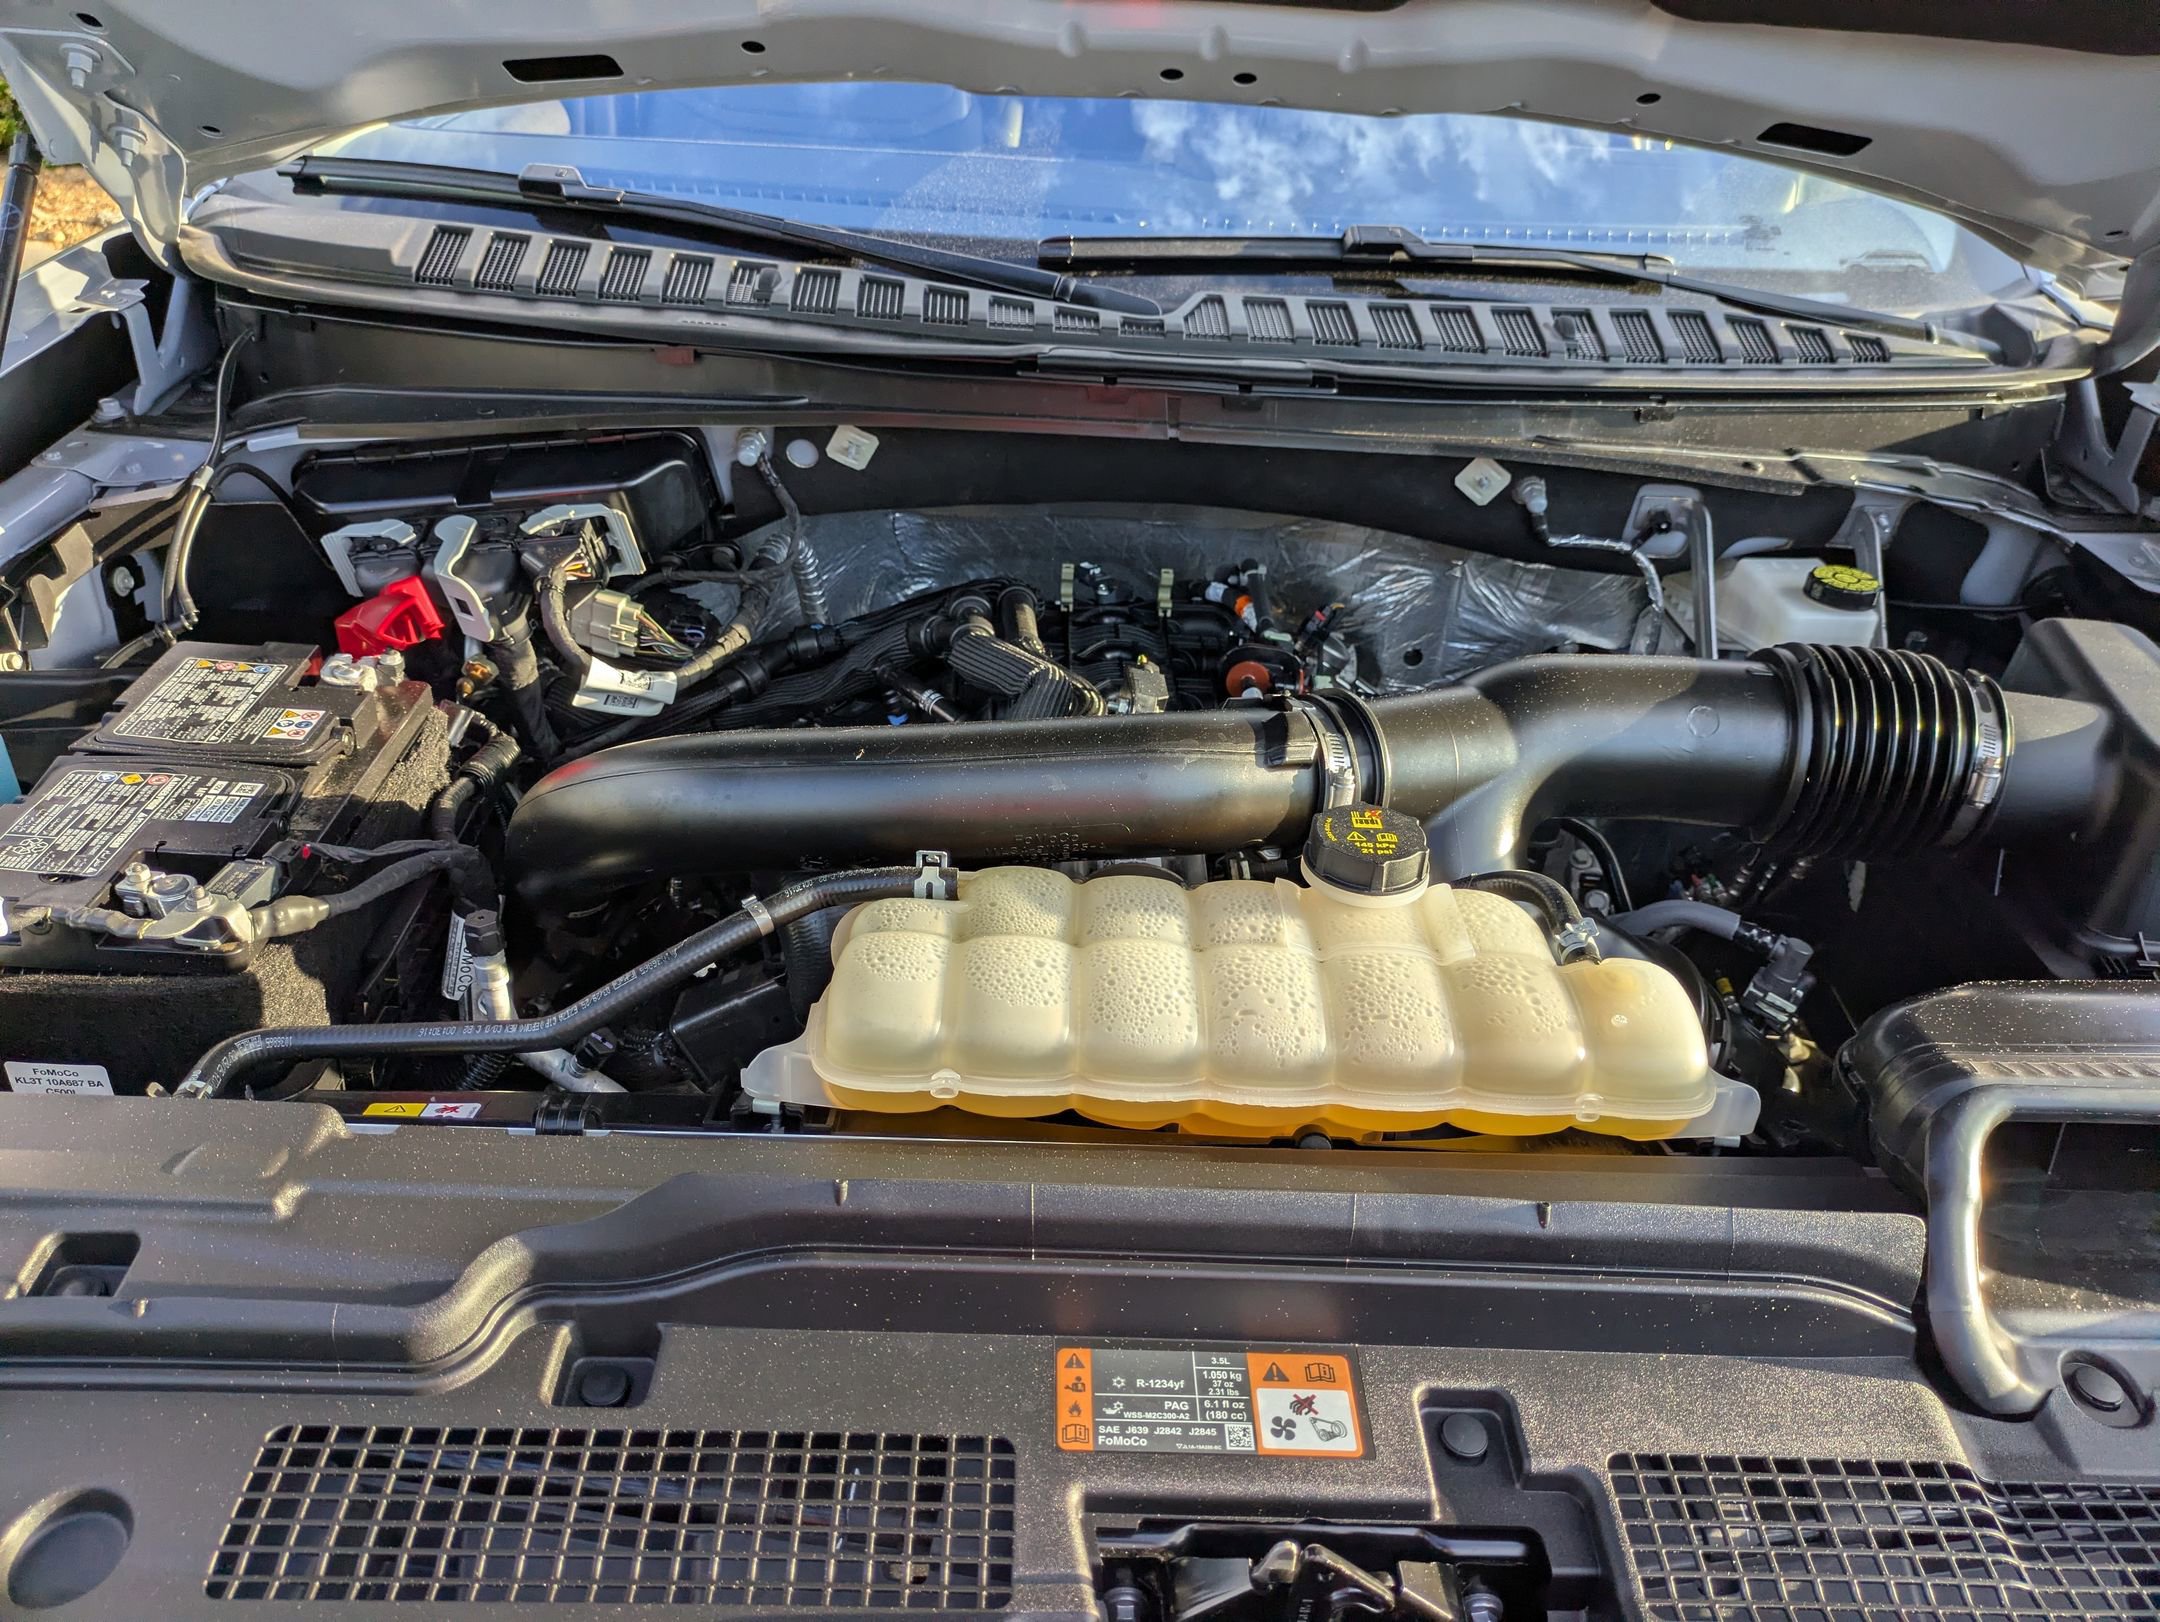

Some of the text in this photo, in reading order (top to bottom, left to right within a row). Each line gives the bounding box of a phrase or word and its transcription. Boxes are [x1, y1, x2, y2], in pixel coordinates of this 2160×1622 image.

[32, 1068, 80, 1078] FoMoCo
[14, 1076, 105, 1088] KL3T 10A687 BA
[1211, 1356, 1231, 1365] 3.5L
[1202, 1370, 1242, 1382] 1.050 kg
[1136, 1378, 1185, 1390] R-1234yf
[1212, 1380, 1222, 1388] 37
[1208, 1388, 1240, 1396] 2.31 lbs
[1164, 1400, 1190, 1410] PAG
[1204, 1400, 1219, 1408] 6.1
[1222, 1400, 1230, 1408] fl
[1124, 1411, 1190, 1420] WSS-M2C300-A2
[1206, 1410, 1248, 1422] (180 cc)
[1098, 1425, 1218, 1436] SAE J639 J2842 J2845
[1098, 1435, 1148, 1446] FoMoCo
